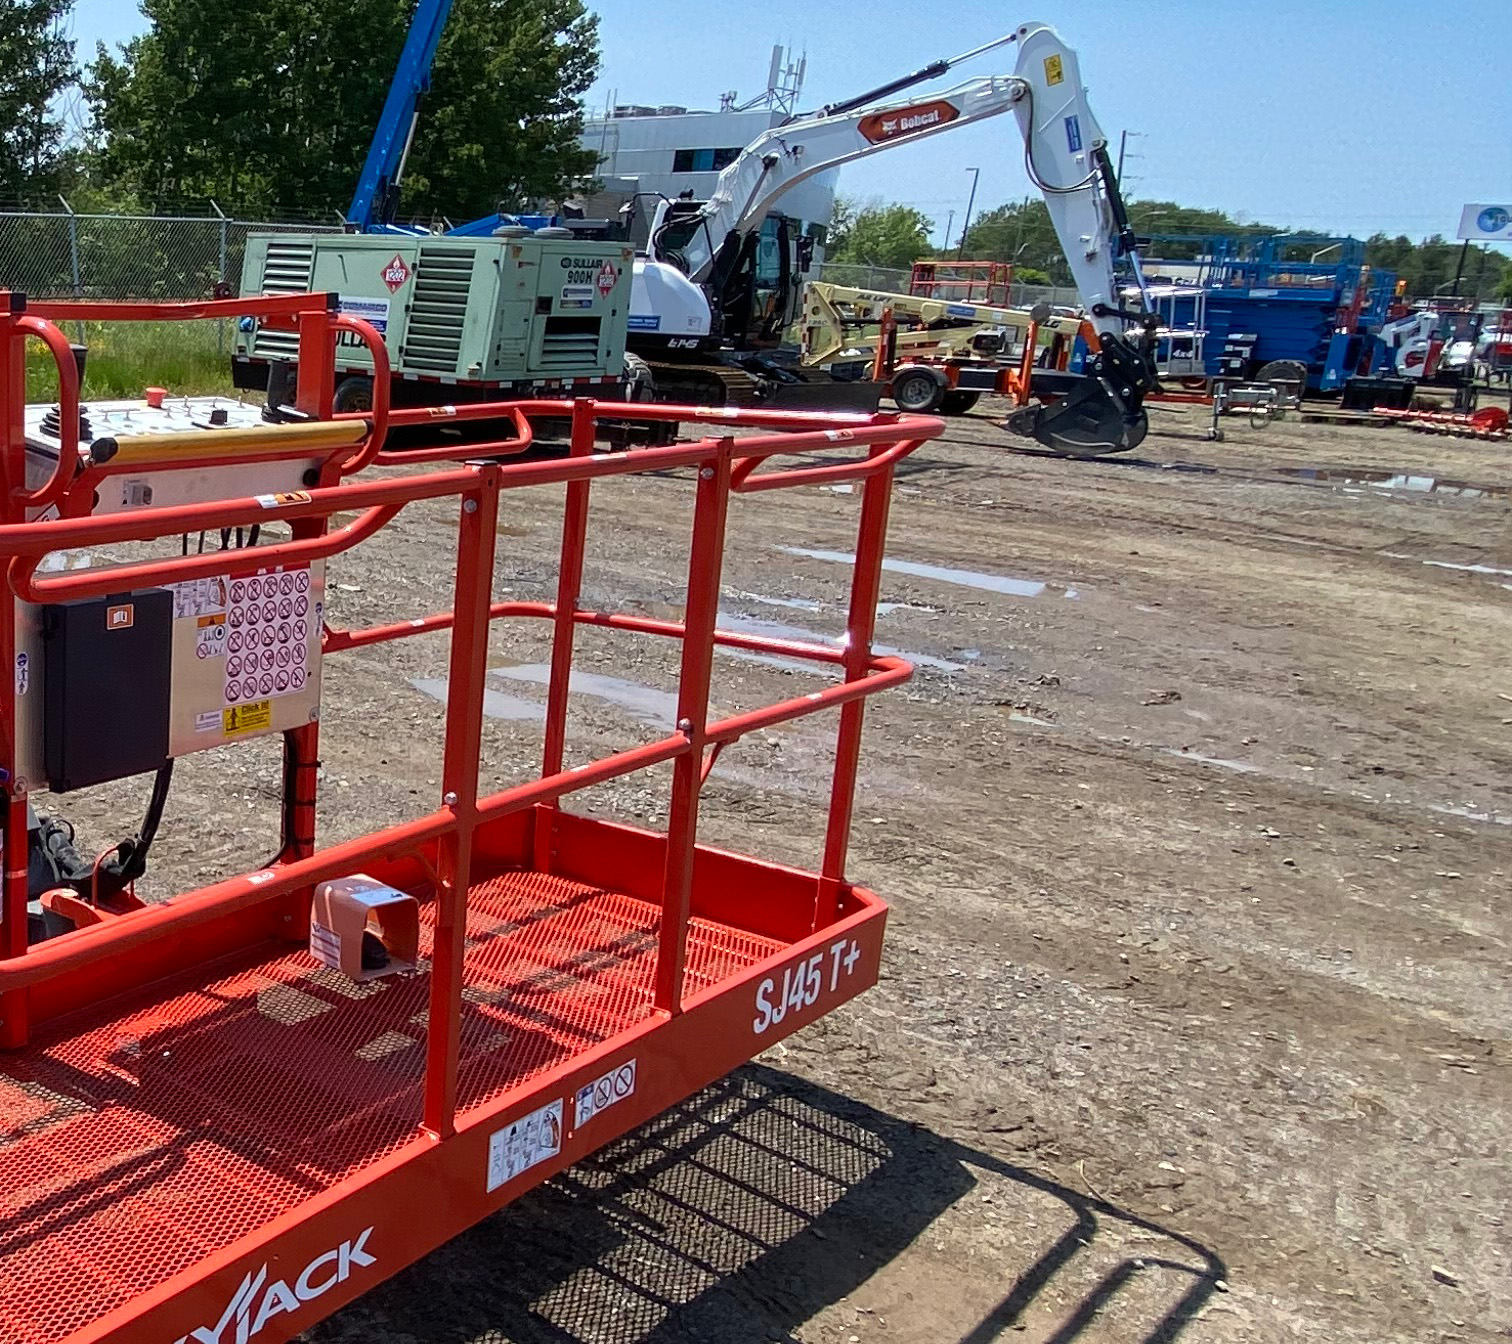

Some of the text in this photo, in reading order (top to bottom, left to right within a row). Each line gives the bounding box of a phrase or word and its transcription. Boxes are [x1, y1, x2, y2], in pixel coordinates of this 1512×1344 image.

[900, 110, 940, 130] Bobcat
[568, 271, 593, 284] 900H
[753, 939, 861, 1034] SJ45 T+
